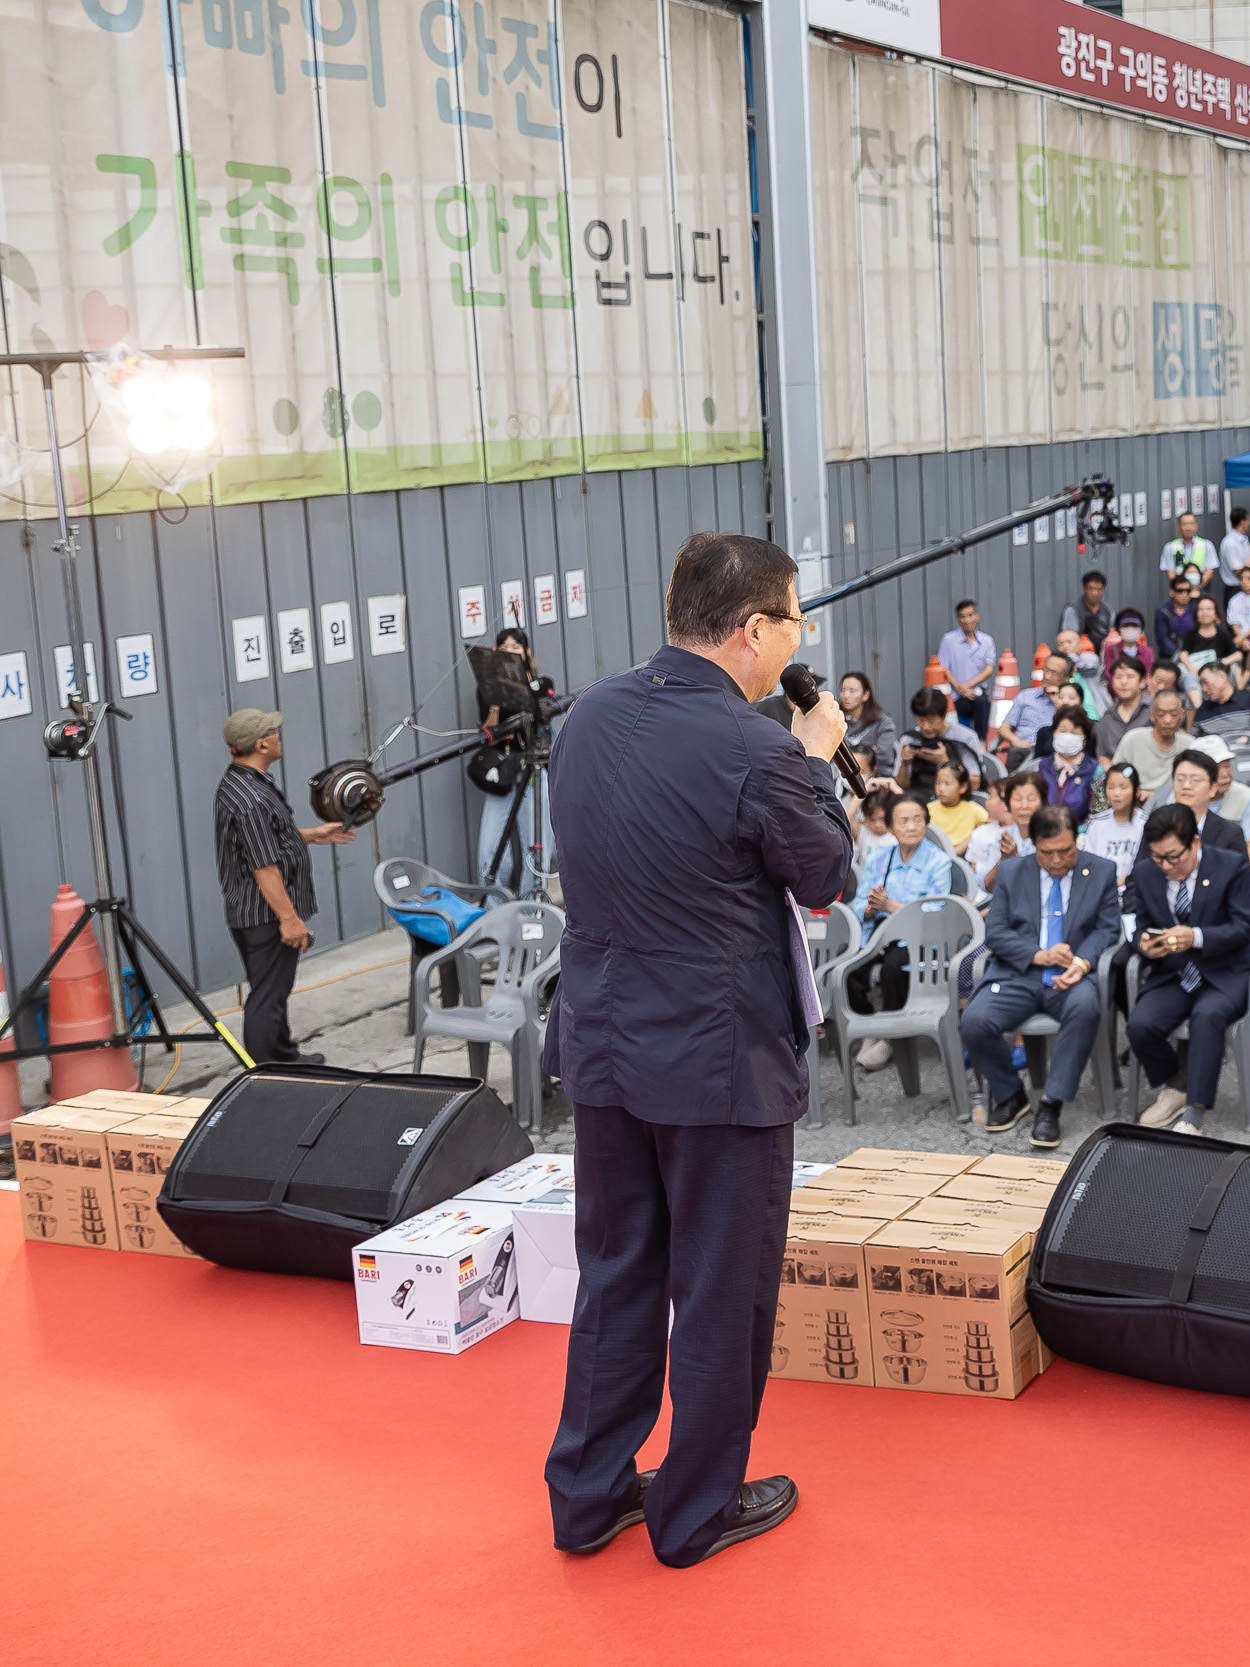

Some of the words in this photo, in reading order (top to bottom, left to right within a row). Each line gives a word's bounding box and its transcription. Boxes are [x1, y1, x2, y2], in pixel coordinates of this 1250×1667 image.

[1056, 25, 1115, 87] 광진구
[1117, 45, 1170, 104] 구의동
[1171, 60, 1233, 122] 청년주택
[94, 149, 402, 306] 가족의
[1040, 300, 1142, 397] 당신의
[357, 1268, 381, 1281] BARI
[458, 1266, 478, 1285] BARI
